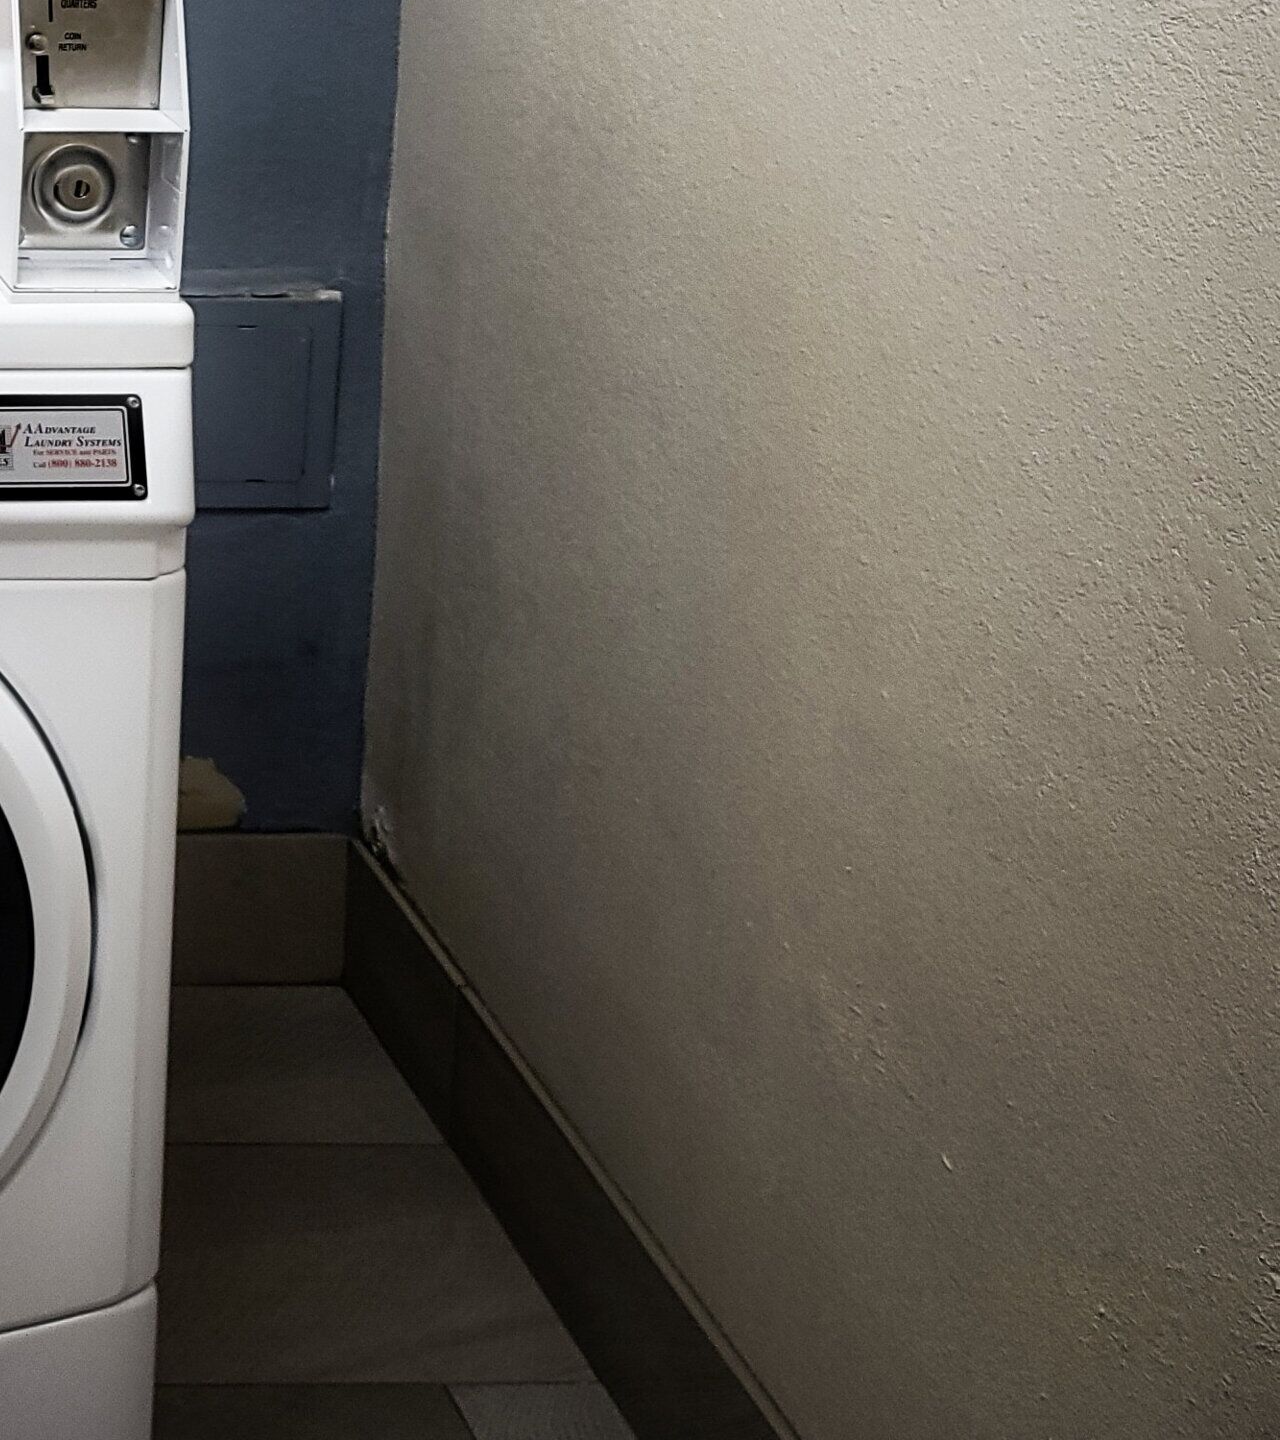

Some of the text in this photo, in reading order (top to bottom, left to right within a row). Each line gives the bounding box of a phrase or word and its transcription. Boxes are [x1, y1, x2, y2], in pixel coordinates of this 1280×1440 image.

[64, 32, 82, 40] COIN
[58, 43, 87, 51] RETURN
[24, 435, 122, 447] LAUNDRY SYSTEMS
